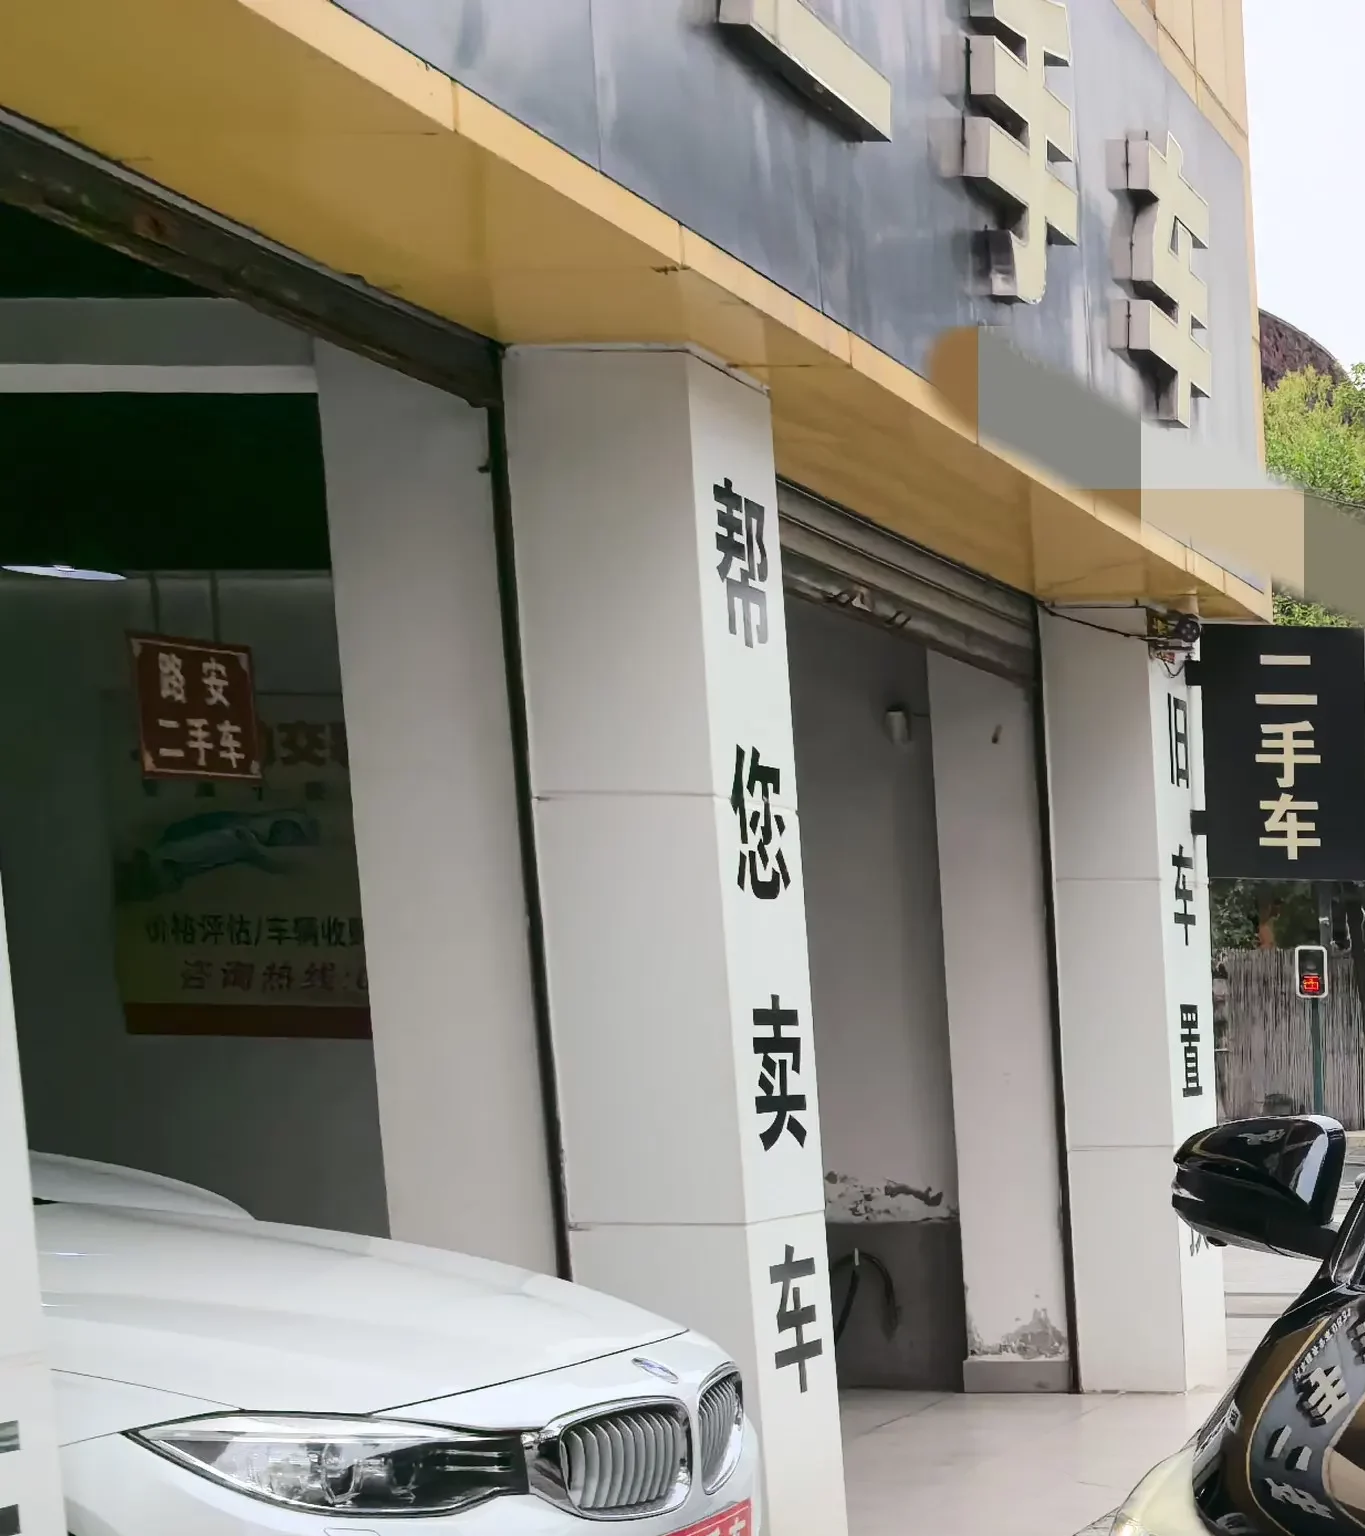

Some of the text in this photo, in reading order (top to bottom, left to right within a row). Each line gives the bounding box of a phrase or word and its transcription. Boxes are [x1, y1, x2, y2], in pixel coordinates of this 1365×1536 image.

[157, 718, 246, 769] 二手车
[713, 477, 823, 1393] 帮您卖车
[1255, 654, 1321, 860] 二手车
[1167, 692, 1210, 1256] 旧车置
